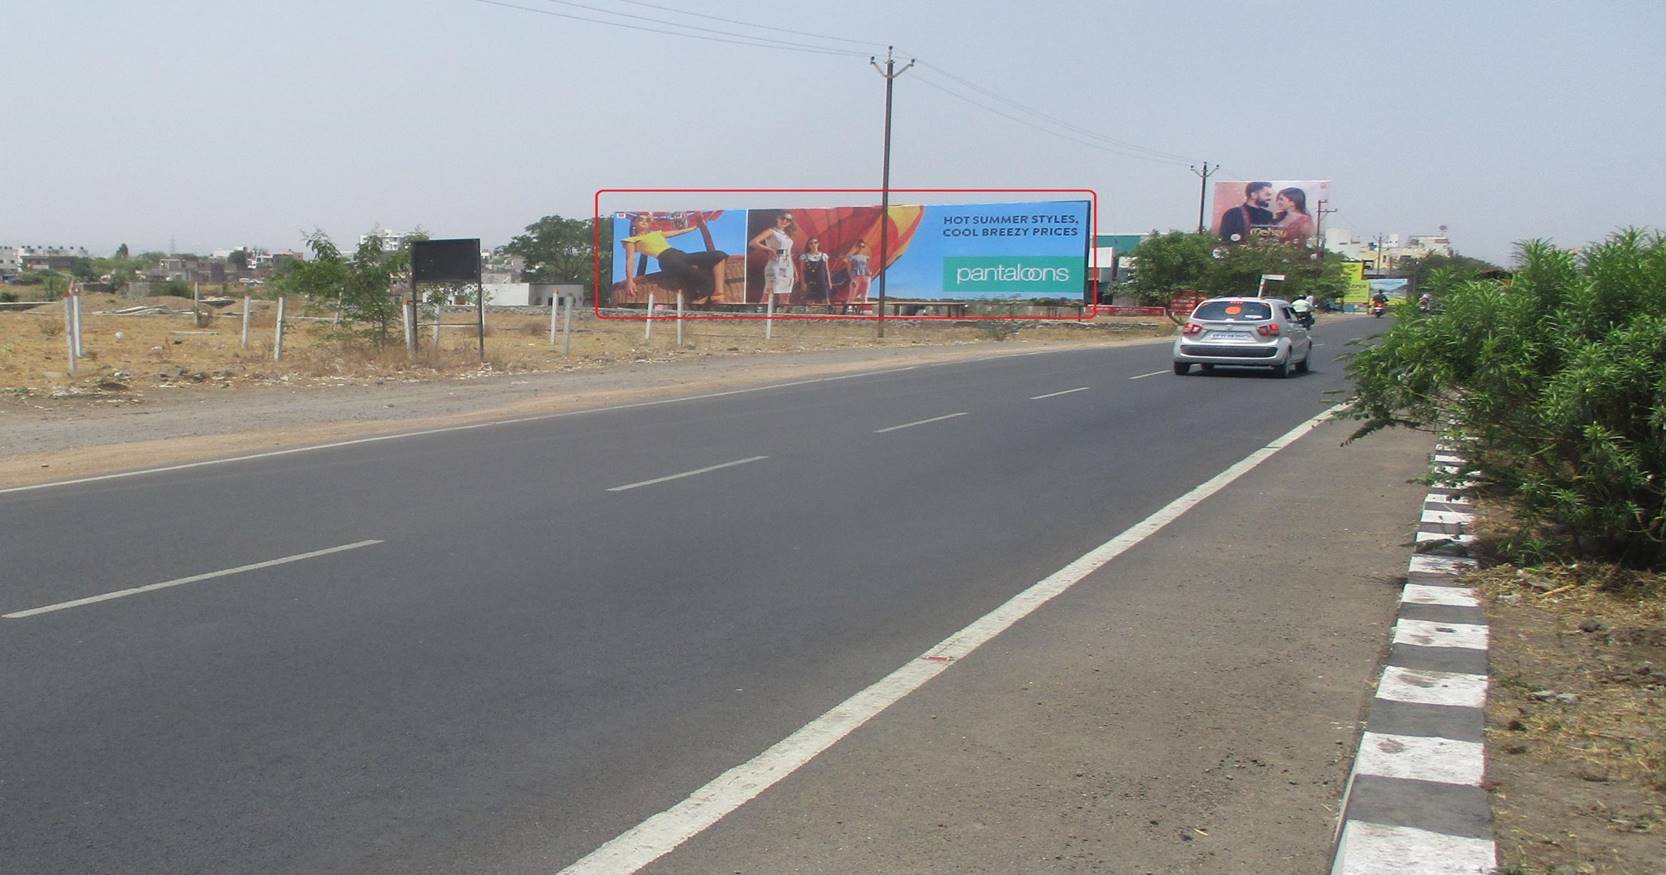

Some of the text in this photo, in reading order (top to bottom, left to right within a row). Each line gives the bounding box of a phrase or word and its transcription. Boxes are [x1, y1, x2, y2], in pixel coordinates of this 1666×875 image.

[944, 215, 1079, 225] HOT SUMMER STYLES,
[943, 227, 1079, 237] COOL BREEZY PRICES
[956, 263, 1070, 286] pantaloons
